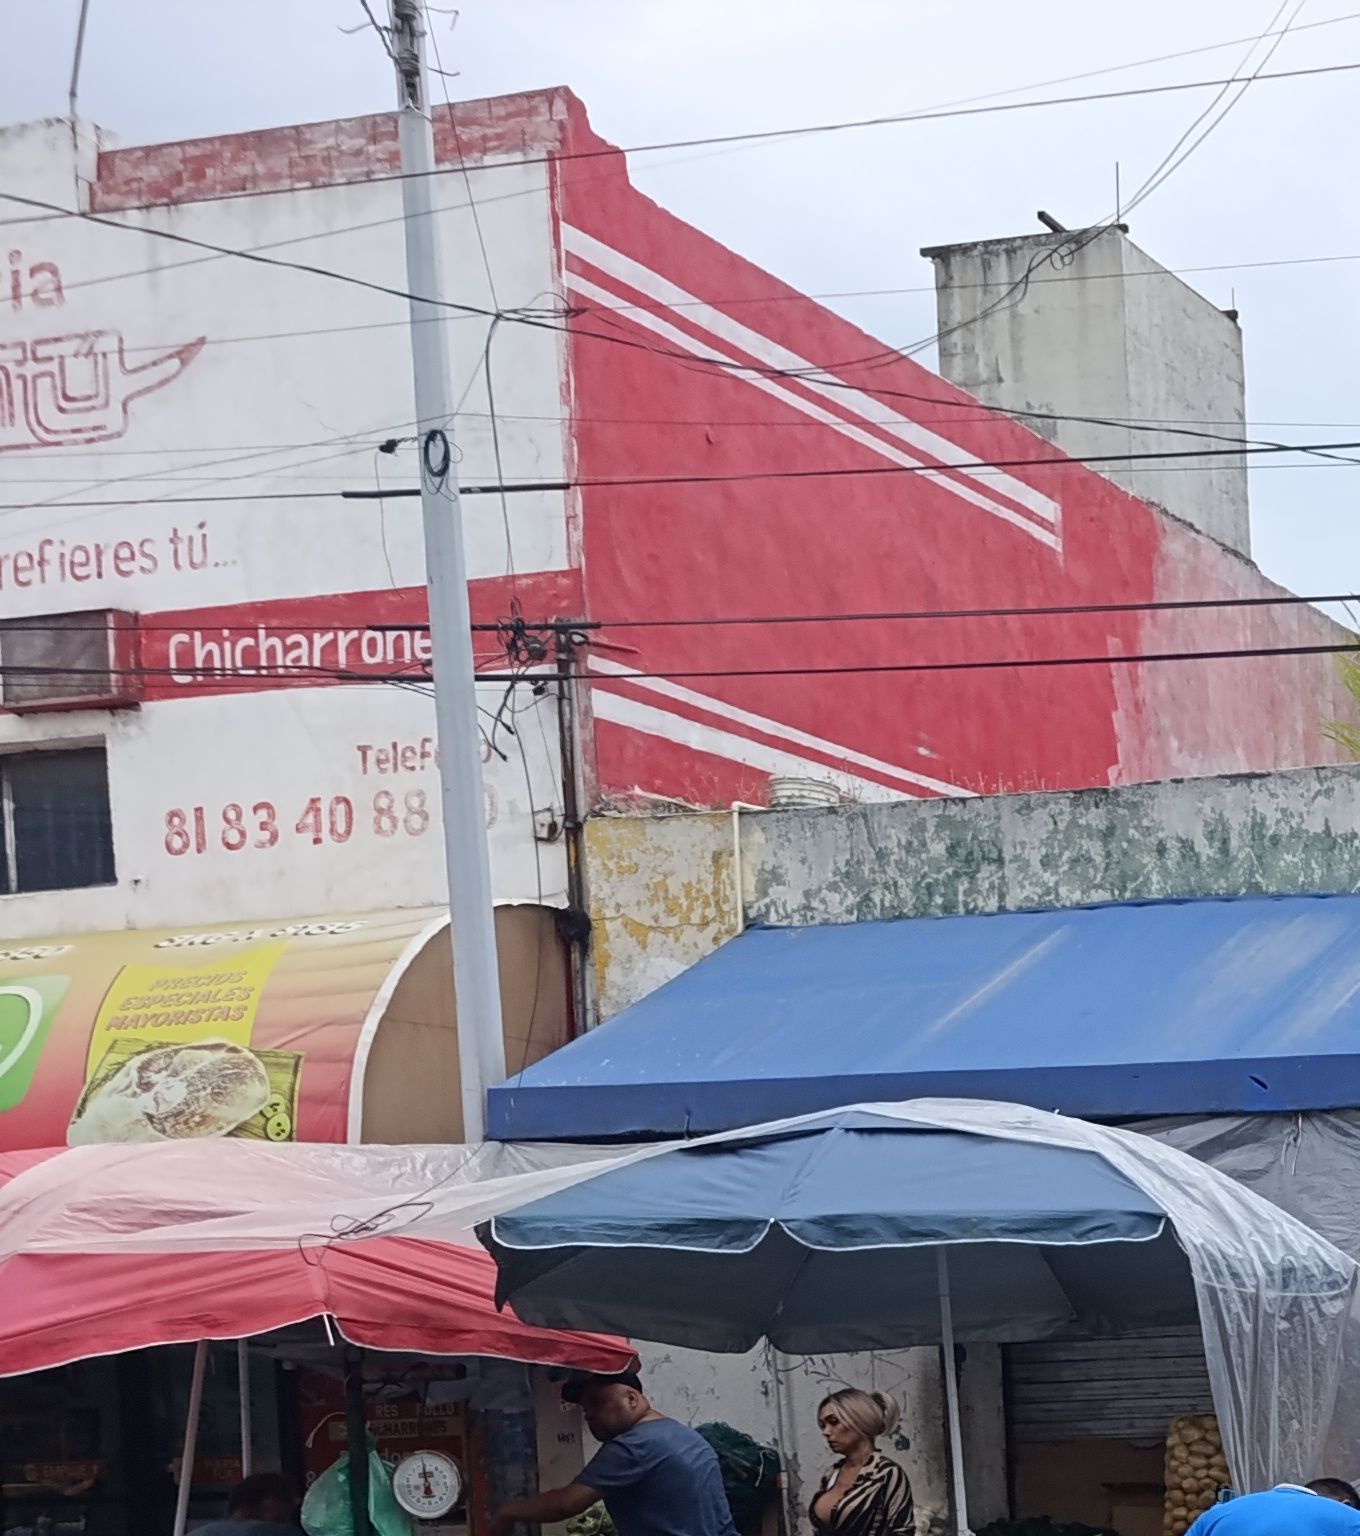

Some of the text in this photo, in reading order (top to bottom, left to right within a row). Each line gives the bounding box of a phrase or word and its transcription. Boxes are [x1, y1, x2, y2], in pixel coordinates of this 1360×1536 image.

[167, 628, 433, 685] Chicharrone
[164, 807, 206, 856] 81
[221, 801, 279, 851] 83
[295, 794, 354, 846] 40
[104, 1005, 249, 1032] MAYORISTAS
[118, 986, 255, 1012] ESPECIALES
